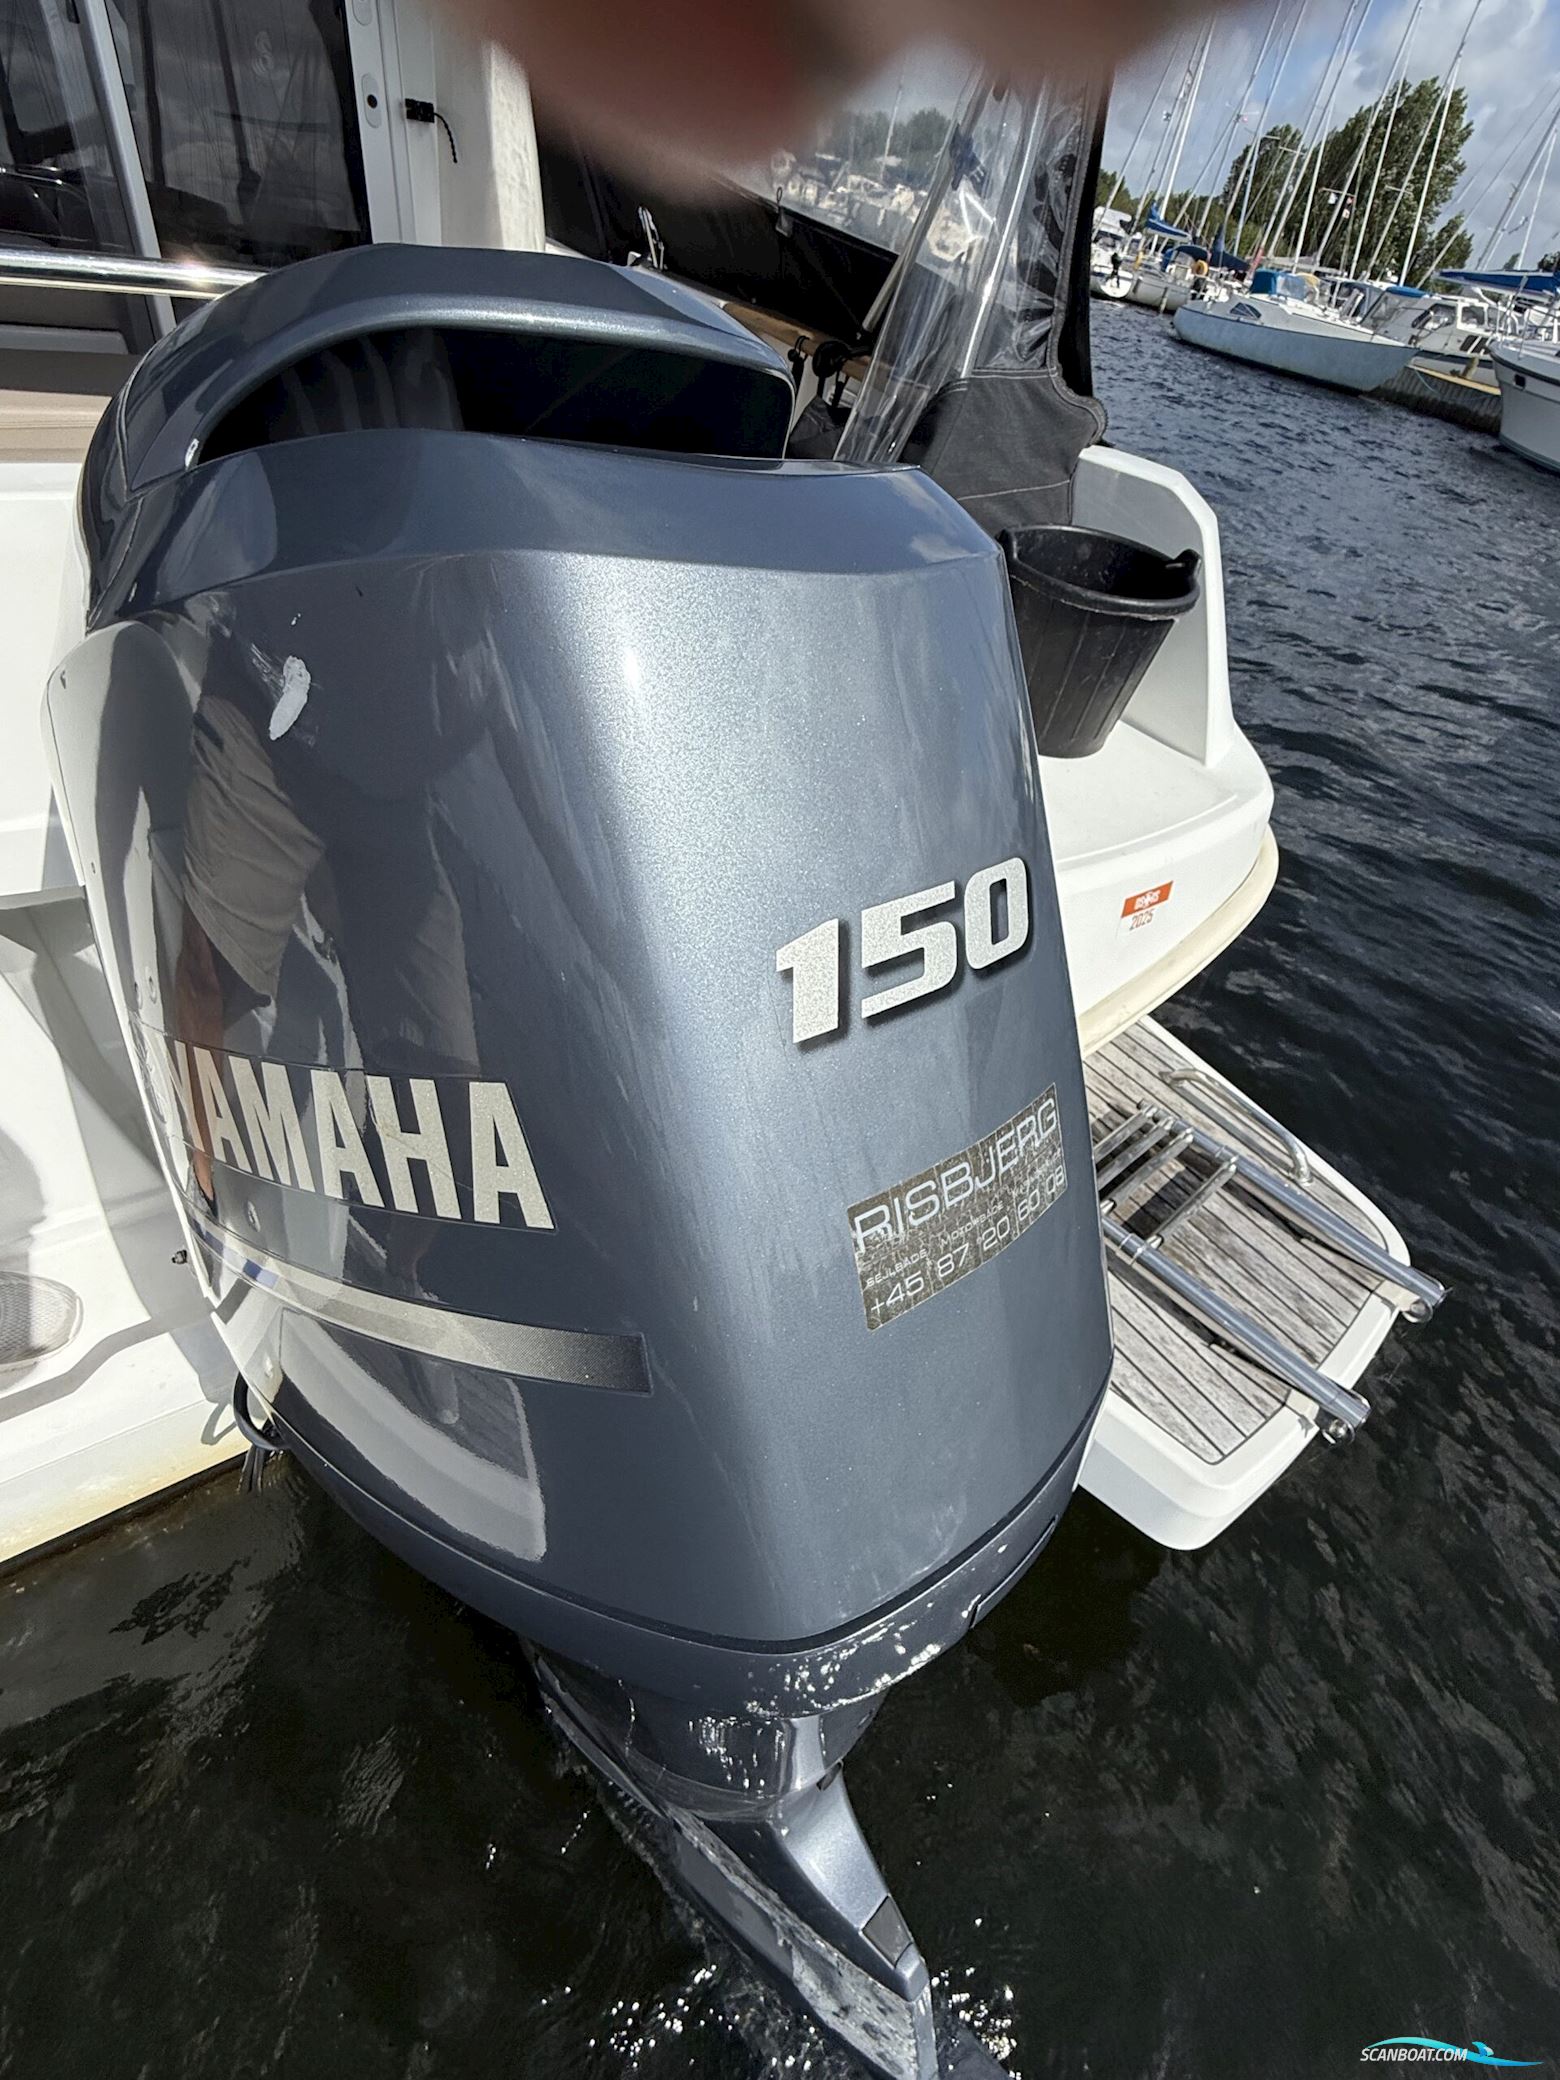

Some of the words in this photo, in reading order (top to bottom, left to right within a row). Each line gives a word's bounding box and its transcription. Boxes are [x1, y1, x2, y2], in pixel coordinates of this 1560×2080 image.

[776, 857, 1029, 1043] 150
[160, 1036, 554, 1230] YAMAHA
[854, 1098, 1057, 1254] RISBJERG
[870, 1271, 924, 1316] +45
[937, 1243, 970, 1279] 87
[983, 1215, 1011, 1251] 20
[1018, 1190, 1040, 1221] 60
